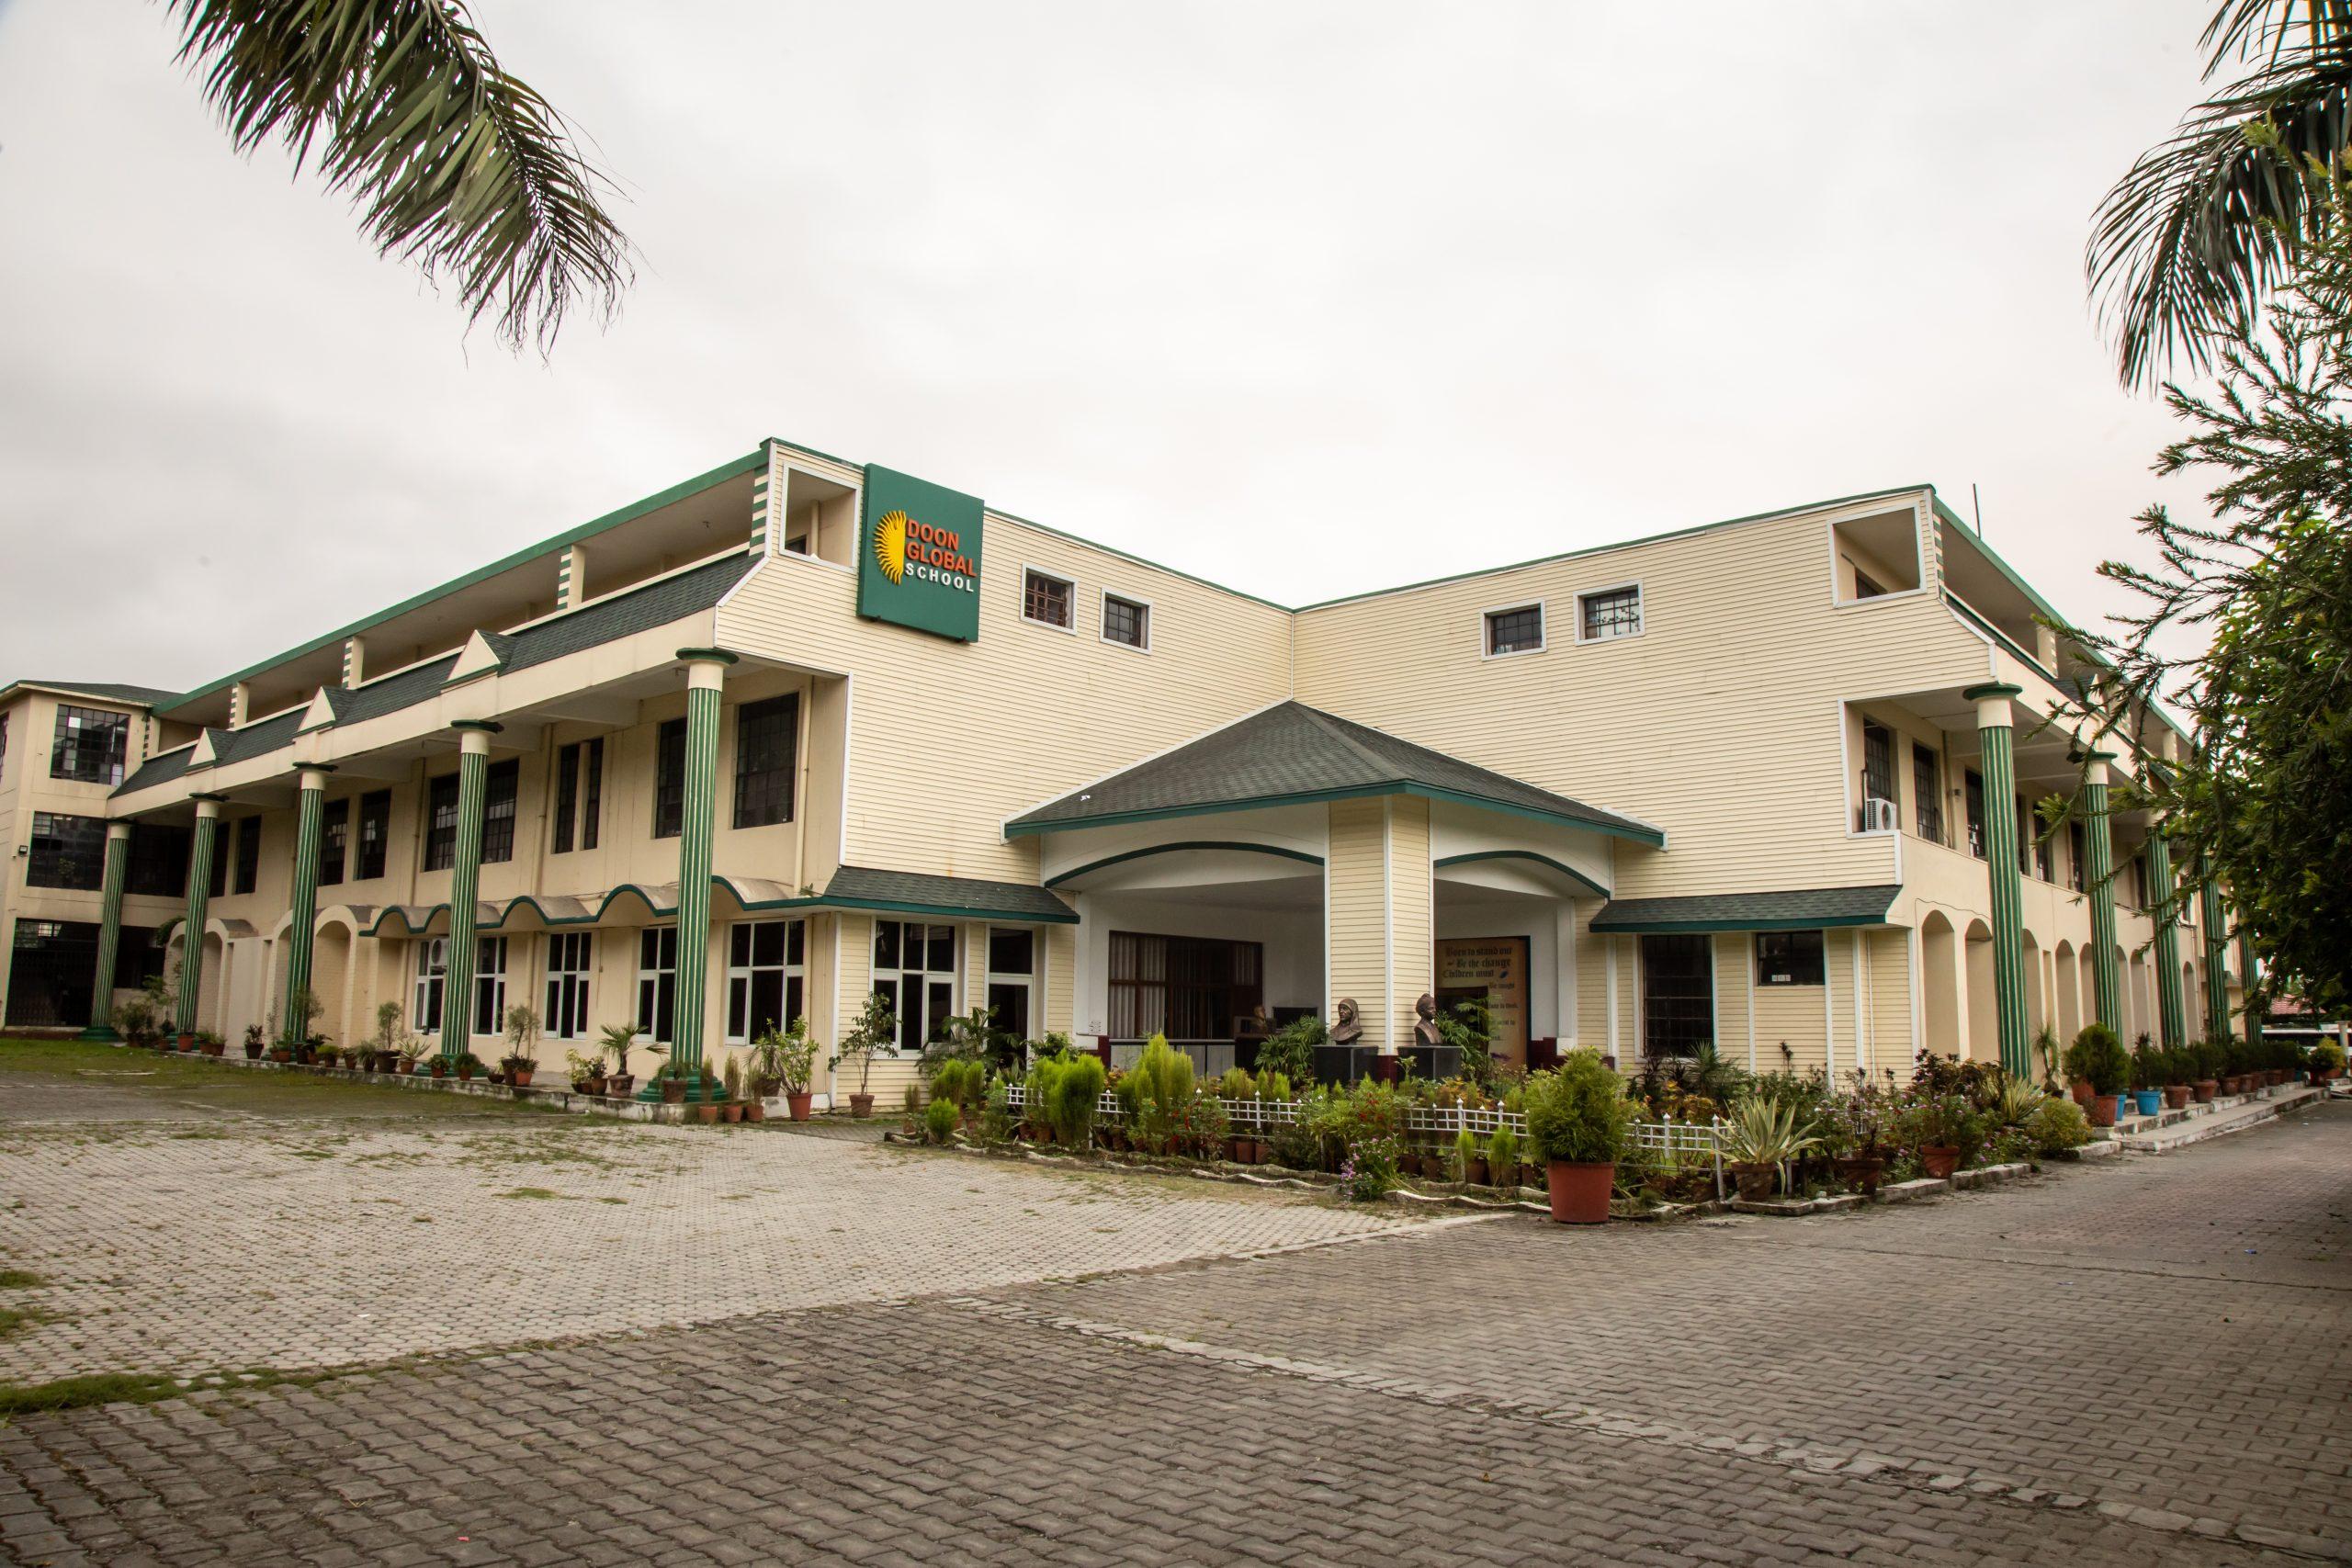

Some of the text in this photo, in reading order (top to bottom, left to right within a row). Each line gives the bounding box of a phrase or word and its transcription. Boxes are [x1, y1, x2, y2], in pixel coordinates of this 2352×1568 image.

[907, 519, 959, 551] DOON
[906, 542, 977, 577] GLOBAL
[905, 562, 974, 592] SCHOOL
